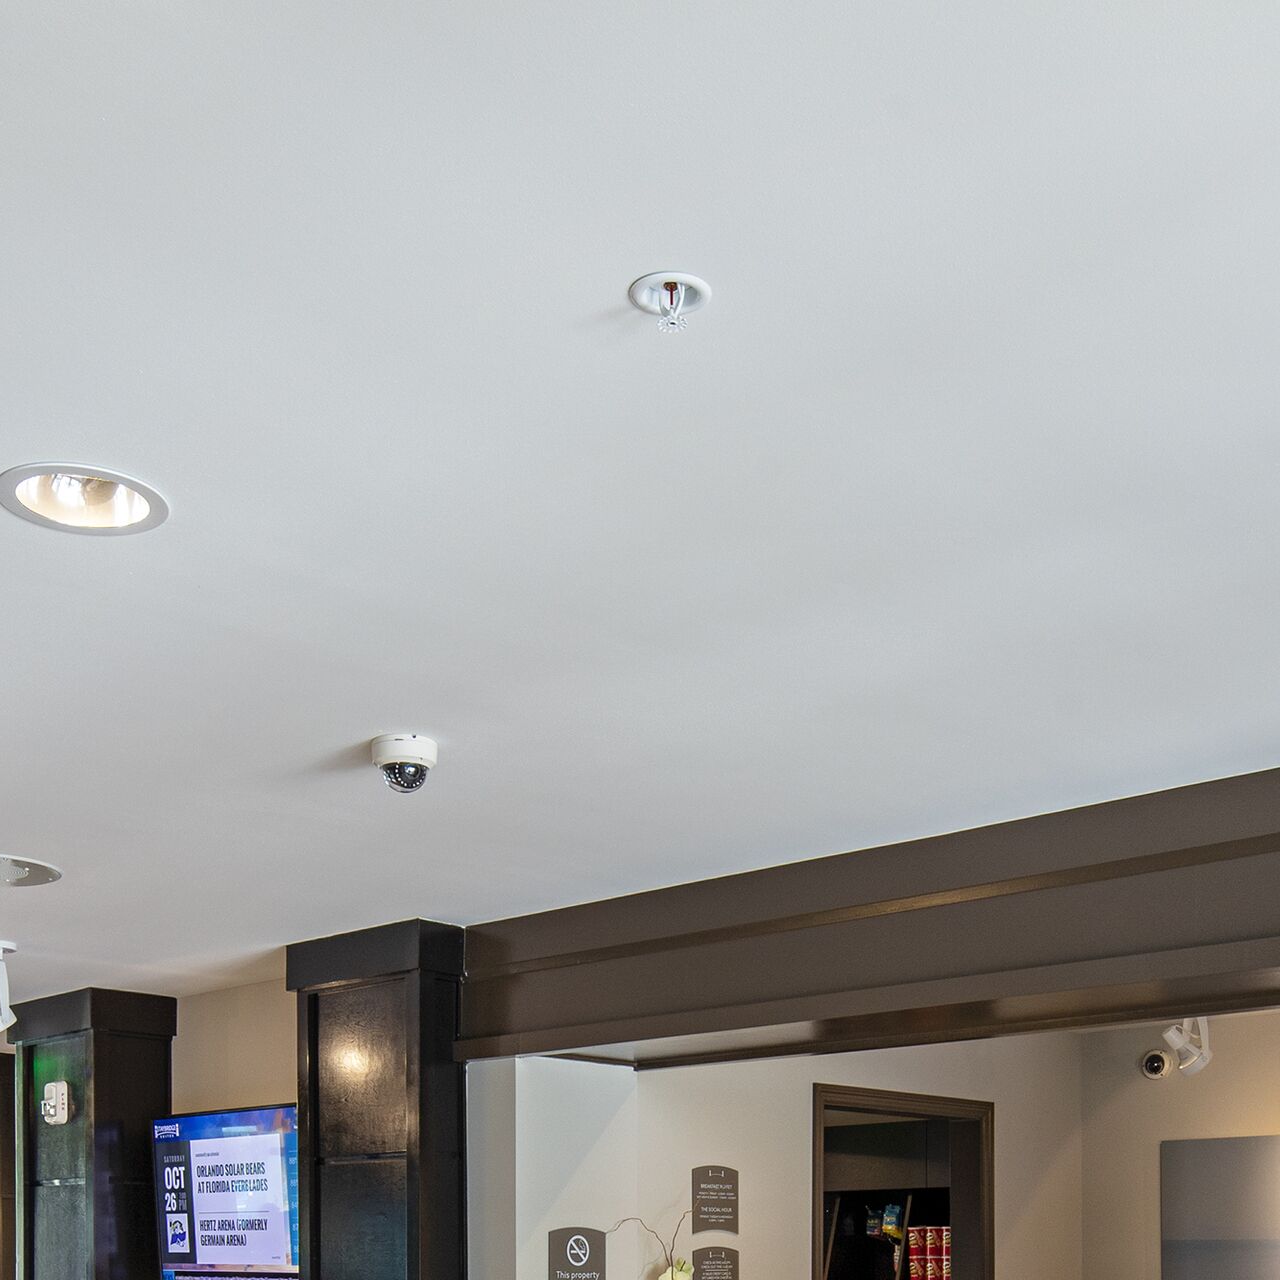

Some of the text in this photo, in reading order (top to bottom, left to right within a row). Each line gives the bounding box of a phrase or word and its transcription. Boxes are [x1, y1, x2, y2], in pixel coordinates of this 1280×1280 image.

[164, 1166, 185, 1190] OCT
[196, 1162, 266, 1178] ORLANDO SOLAR BEARS
[197, 1178, 268, 1194] AT FLORIDA EVERGLADES
[164, 1192, 177, 1212] 26
[200, 1218, 268, 1232] HERTZ ARENA (FORMERLY
[200, 1234, 247, 1247] GERMAIN ARENA)
[556, 1270, 569, 1280] This
